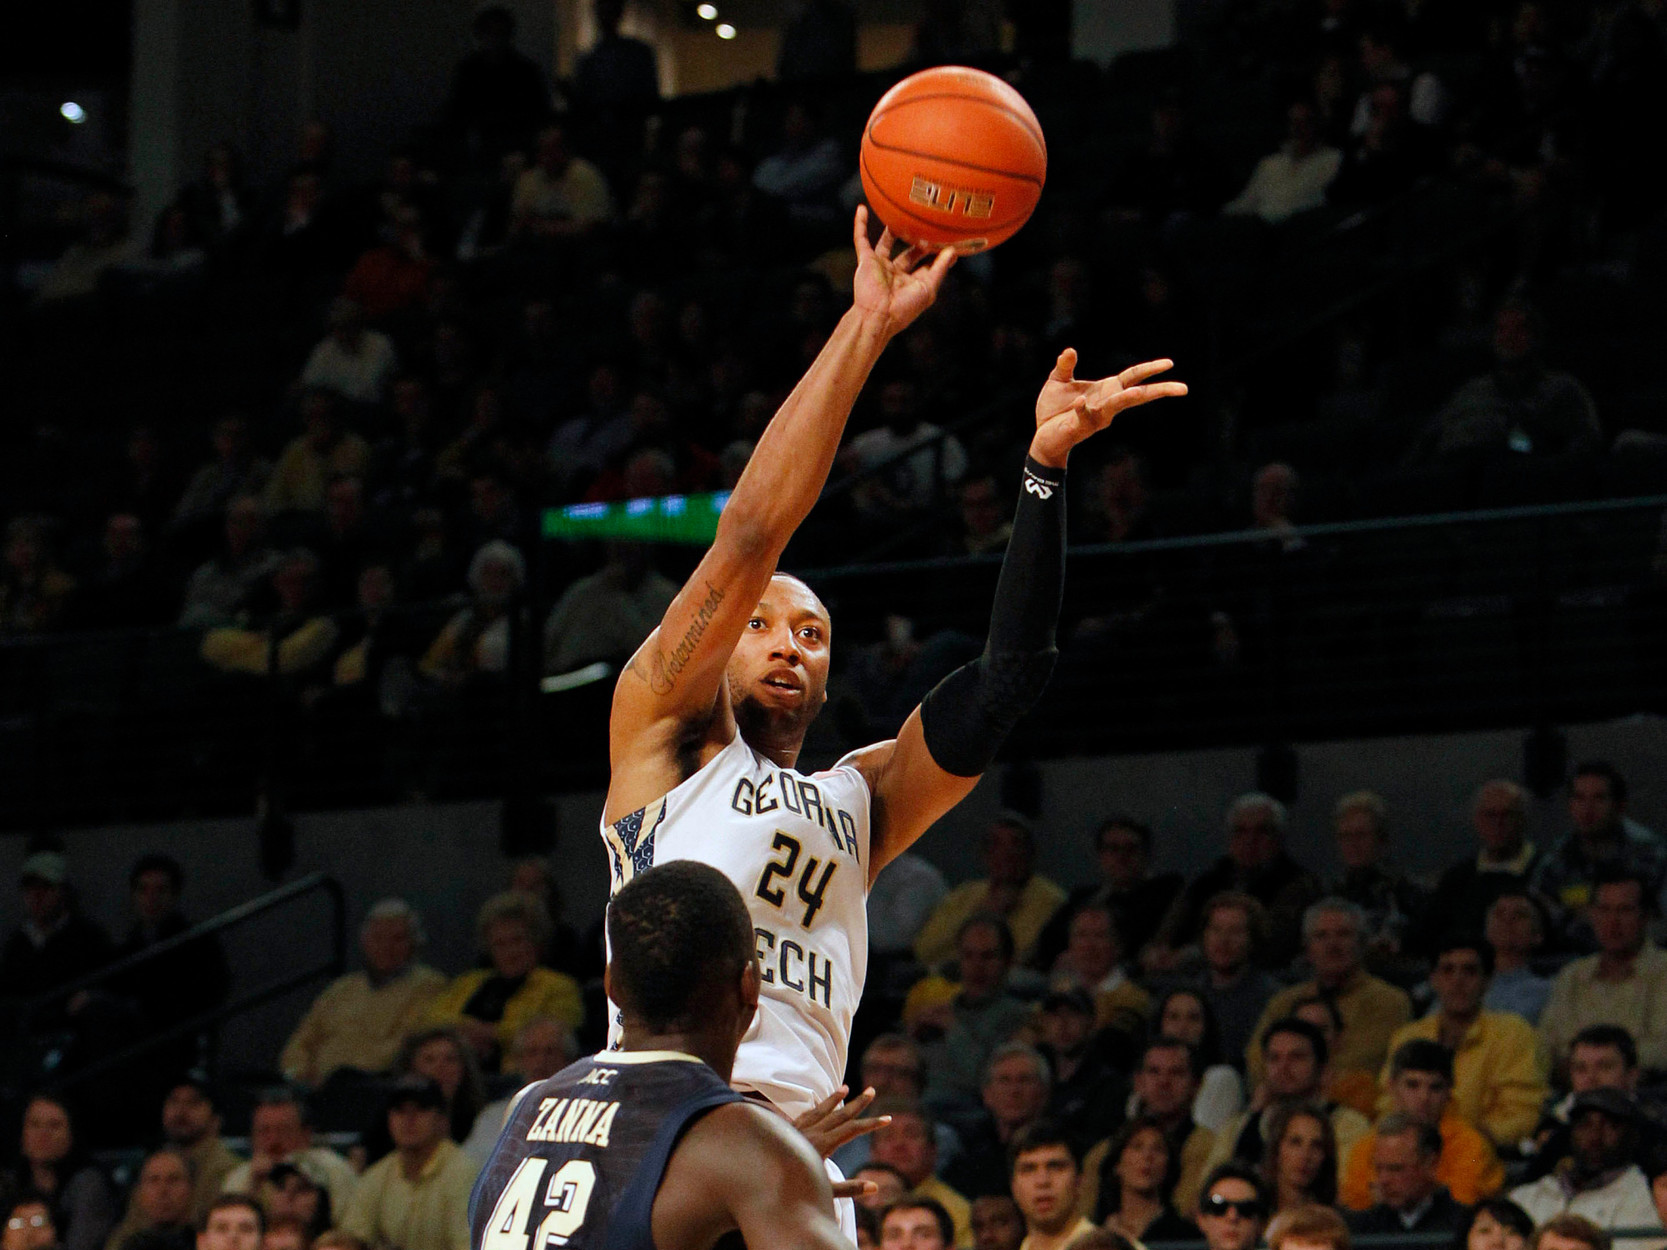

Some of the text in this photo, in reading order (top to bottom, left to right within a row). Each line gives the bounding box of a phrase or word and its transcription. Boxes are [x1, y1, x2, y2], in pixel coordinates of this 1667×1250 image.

[909, 175, 996, 219] ELITE
[732, 771, 860, 864] GEORIA
[756, 829, 837, 929] 24
[753, 927, 832, 1009] ECH
[526, 1097, 621, 1147] ZANNA
